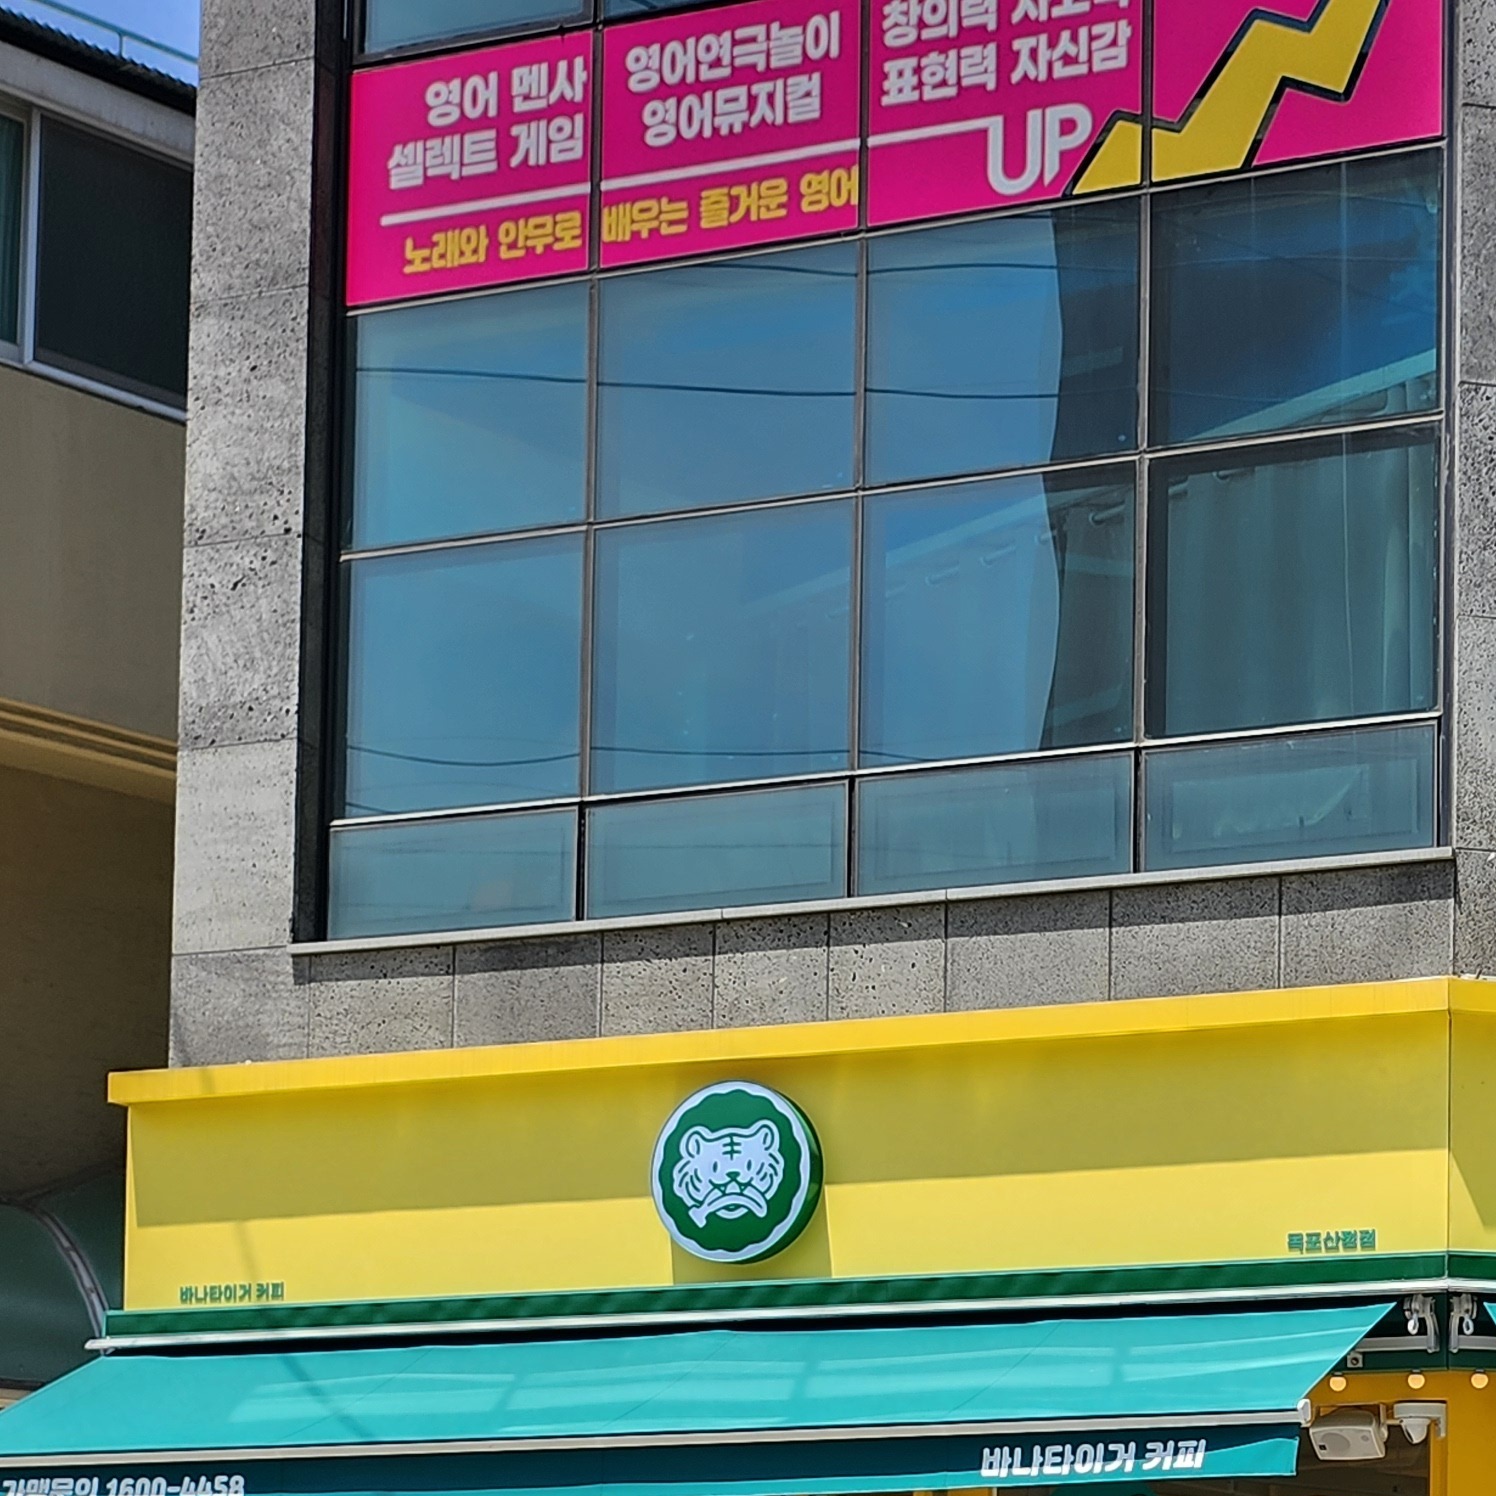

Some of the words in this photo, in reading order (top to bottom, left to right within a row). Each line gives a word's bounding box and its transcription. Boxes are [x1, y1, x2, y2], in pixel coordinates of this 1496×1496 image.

[625, 9, 840, 93] 영어연극놀이
[881, 0, 998, 48] 창의력
[425, 72, 498, 128] 영어
[511, 55, 588, 112] 멘사
[880, 42, 998, 107] 표현력
[1010, 19, 1132, 85] 자신감
[641, 72, 823, 148] 영어뮤지컬
[386, 127, 498, 190] 셀렉트
[509, 112, 585, 169] 게임
[987, 103, 1093, 196] UP
[402, 226, 489, 275] 노래와
[499, 210, 583, 261] 안무로
[601, 198, 689, 243] 배우는
[699, 178, 788, 228] 즐거운
[800, 164, 859, 213] 영어
[180, 1284, 252, 1304] 바나타이거
[256, 1282, 284, 1300] 커피
[980, 1443, 1135, 1478] 바나타이거
[1142, 1439, 1207, 1472] 커피
